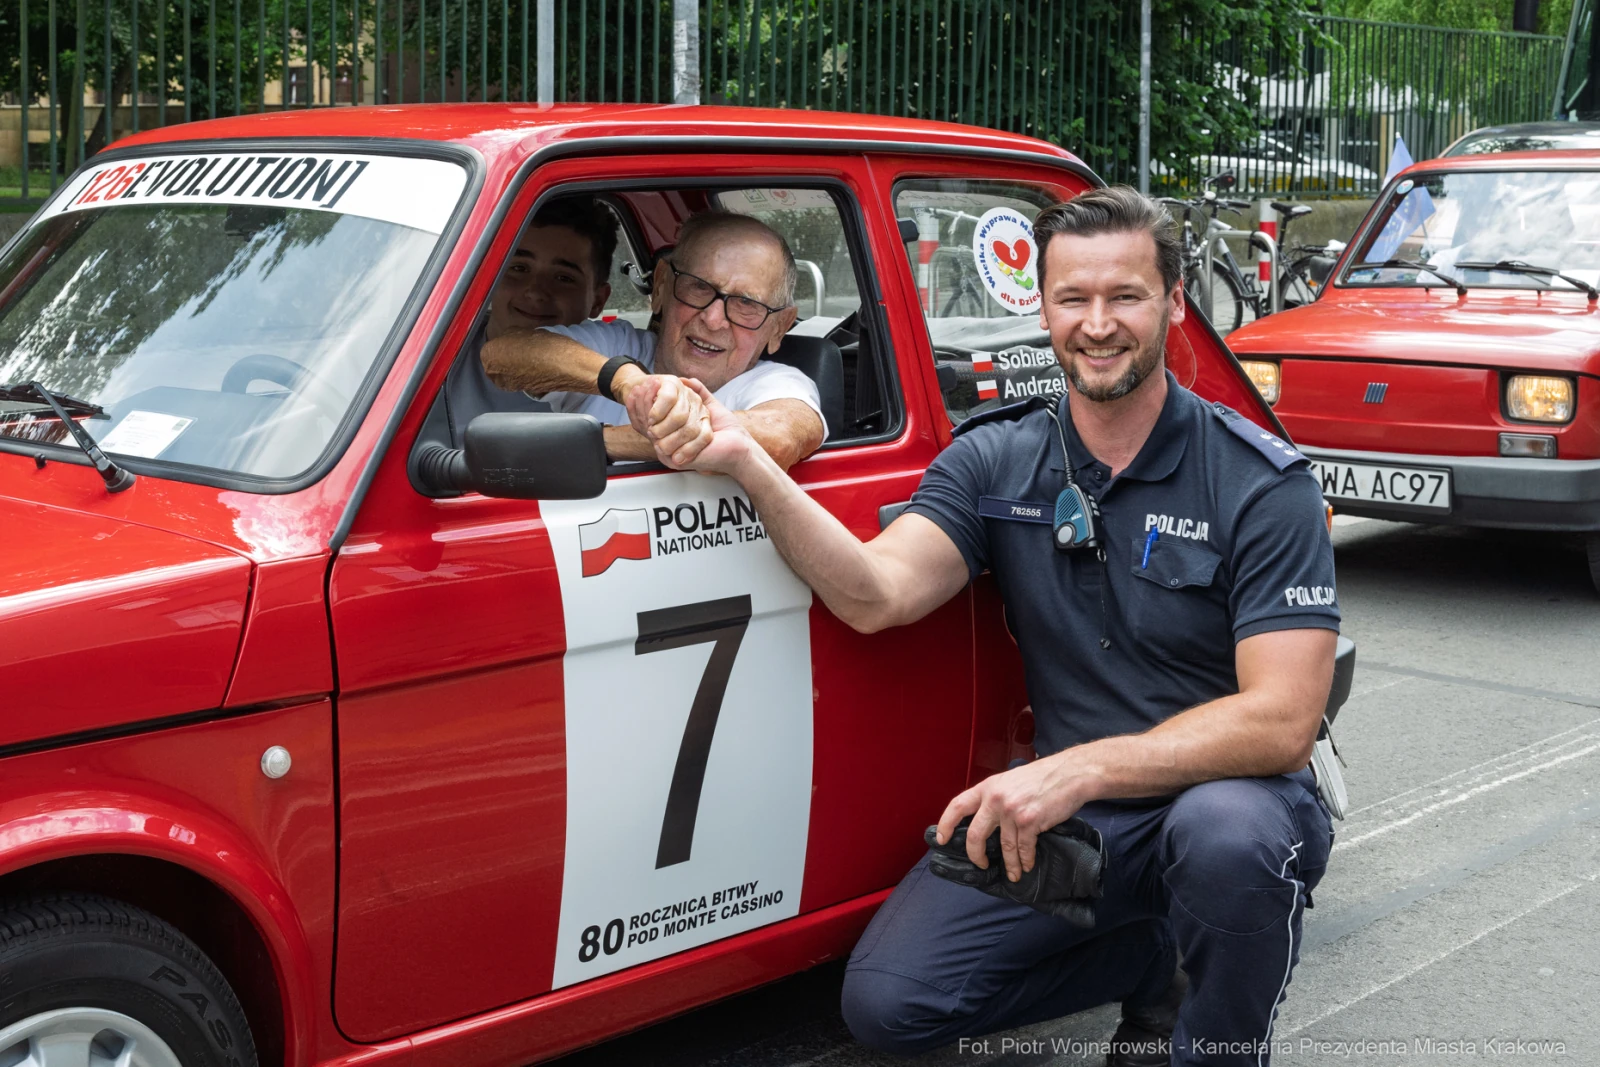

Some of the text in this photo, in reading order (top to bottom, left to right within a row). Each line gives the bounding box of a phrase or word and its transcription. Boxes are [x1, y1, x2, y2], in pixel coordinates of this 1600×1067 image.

[979, 214, 1035, 289] Wielka Wyprawa Ma
[1000, 291, 1041, 306] dla Dziec
[998, 348, 1059, 370] Sobies
[1371, 470, 1444, 504] AC97
[653, 496, 763, 538] POLAN
[1011, 506, 1042, 517] 762555
[1145, 514, 1209, 541] POLICJA
[657, 525, 768, 556] NATIONAL TEA
[634, 594, 753, 870] 7
[627, 890, 784, 948] POD MONTE CASSINO
[629, 880, 759, 931] ROCZNICA BITWY
[578, 918, 625, 963] 80
